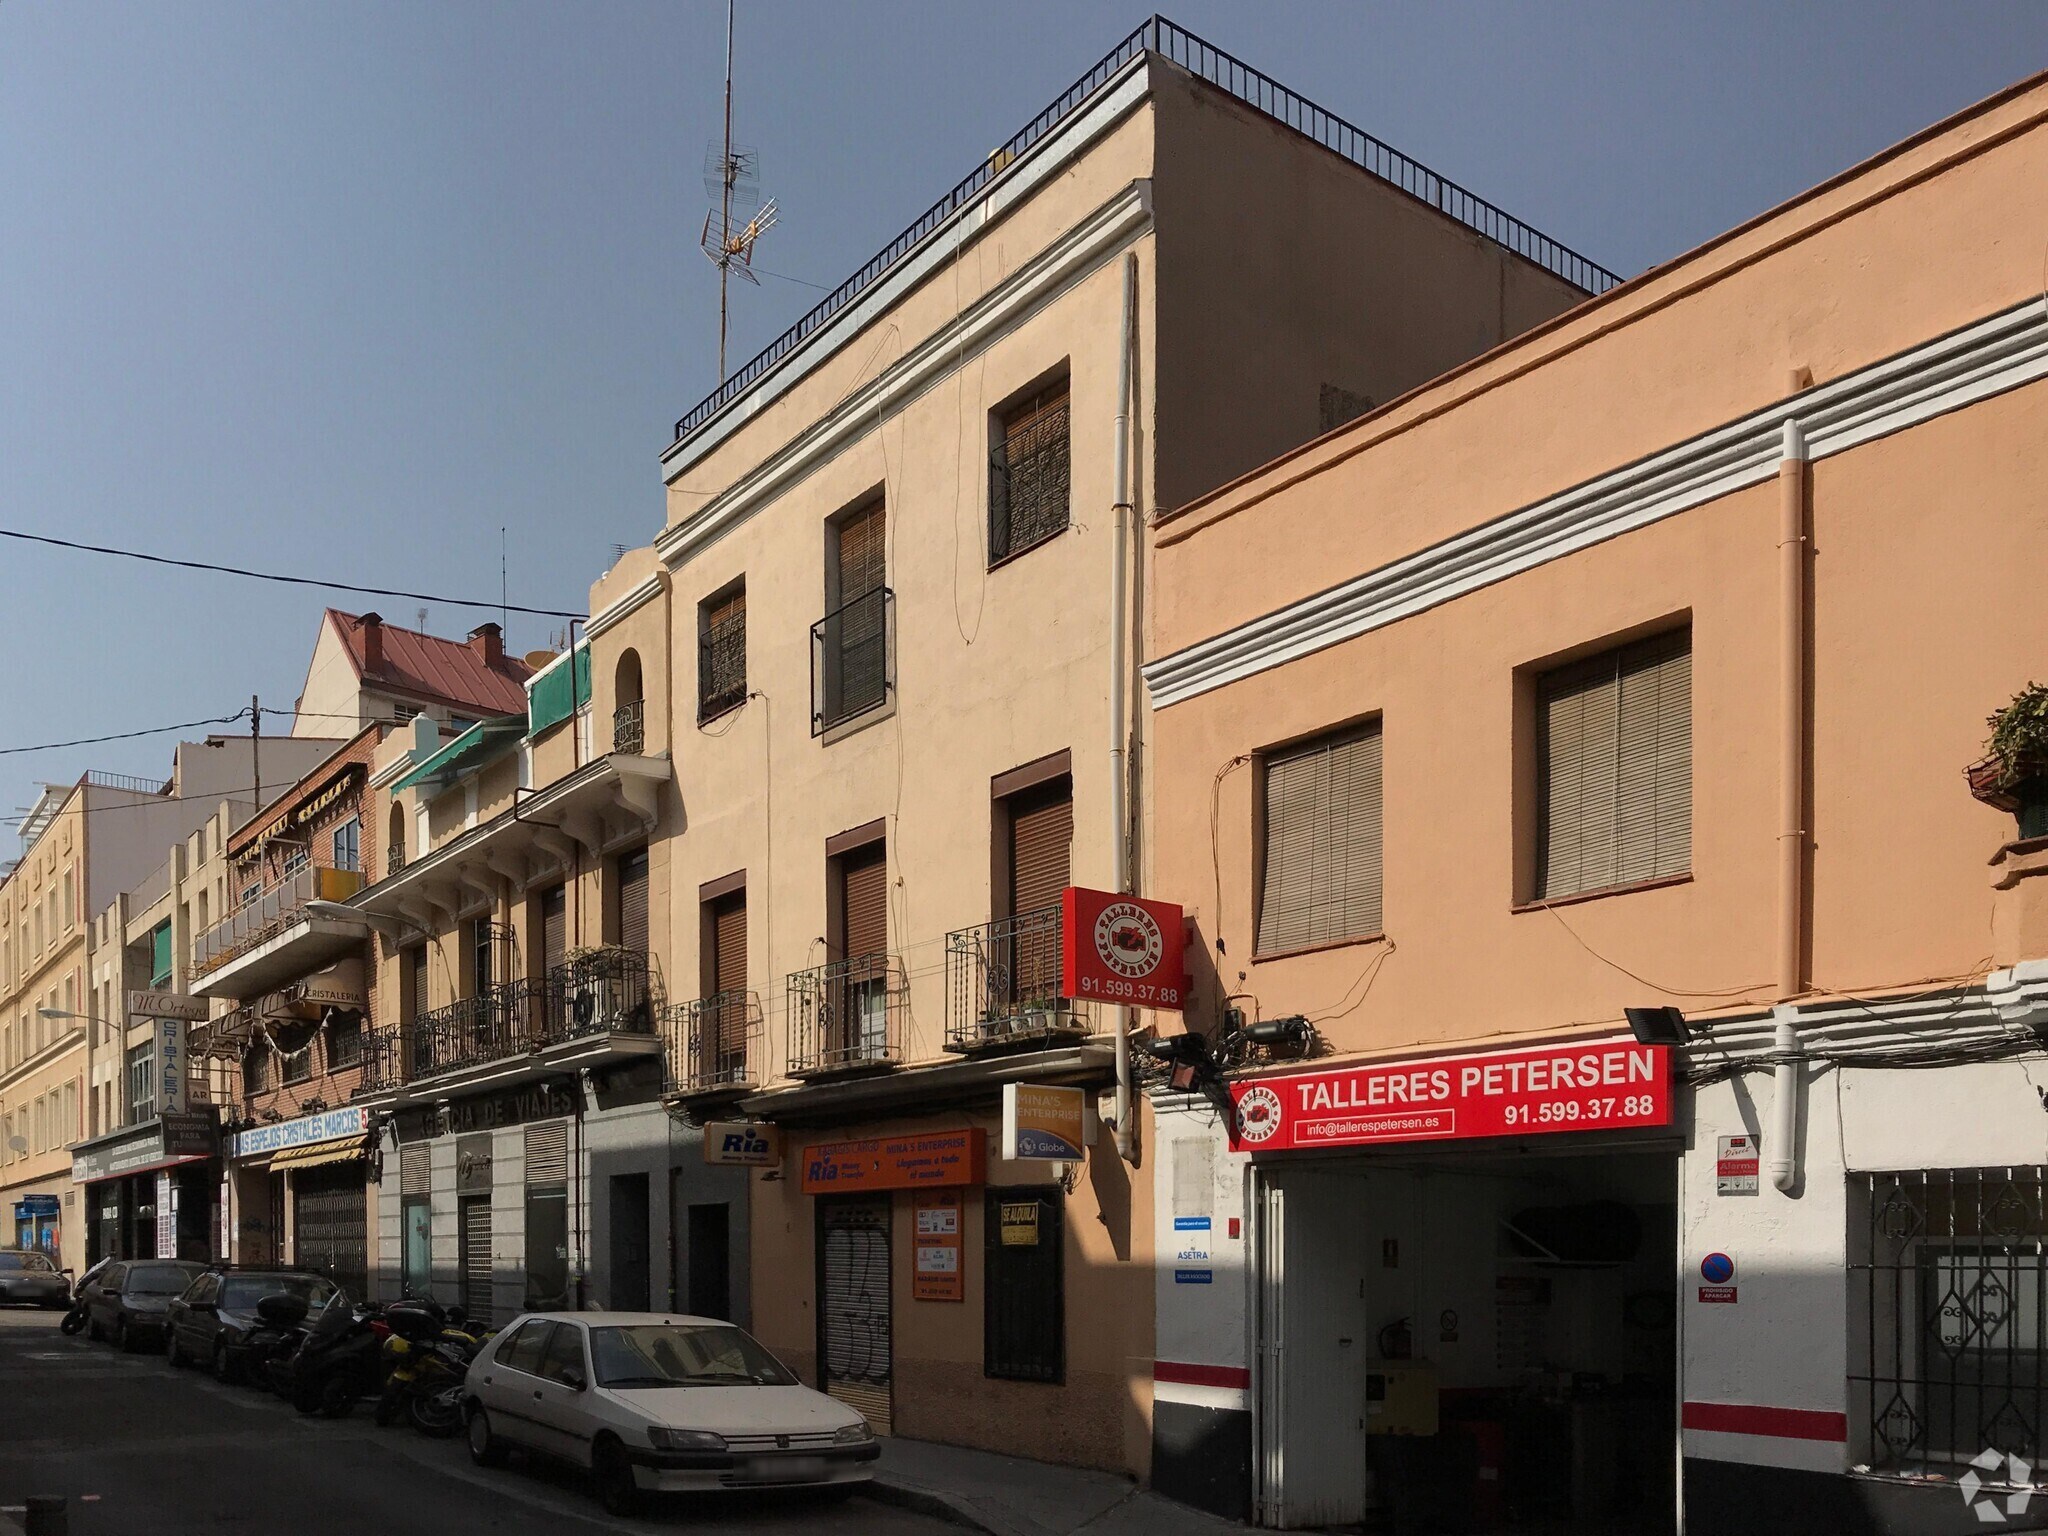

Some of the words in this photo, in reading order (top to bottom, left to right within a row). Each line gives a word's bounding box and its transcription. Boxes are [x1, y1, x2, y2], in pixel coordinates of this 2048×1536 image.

[1099, 905, 1158, 937] TALLERES
[1099, 942, 1159, 976] PETERSEN
[306, 989, 360, 1001] CRISTALERIA
[1081, 976, 1178, 1003] 91.599.37.88
[164, 1021, 177, 1112] CRISTALERIA
[1297, 1069, 1450, 1111] TALLERES
[1461, 1049, 1654, 1098] PETERSEN
[418, 1106, 474, 1137] AGECIA
[485, 1099, 504, 1126] DE
[515, 1091, 572, 1122] VIAJES
[1018, 1107, 1080, 1120] ENTERPRISE
[1504, 1094, 1654, 1125] 91.599.37.88
[250, 1126, 280, 1151] ESPEJOS
[283, 1117, 322, 1146] CRISTALES
[325, 1108, 359, 1137] MARCOS
[1307, 1115, 1439, 1136] info@tallerespetersen.es
[722, 1127, 769, 1153] Ria
[917, 1137, 965, 1152] ENTERPRISE
[1038, 1142, 1065, 1153] Globe
[808, 1154, 838, 1181] Ria
[1178, 1251, 1209, 1260] ASETRA
